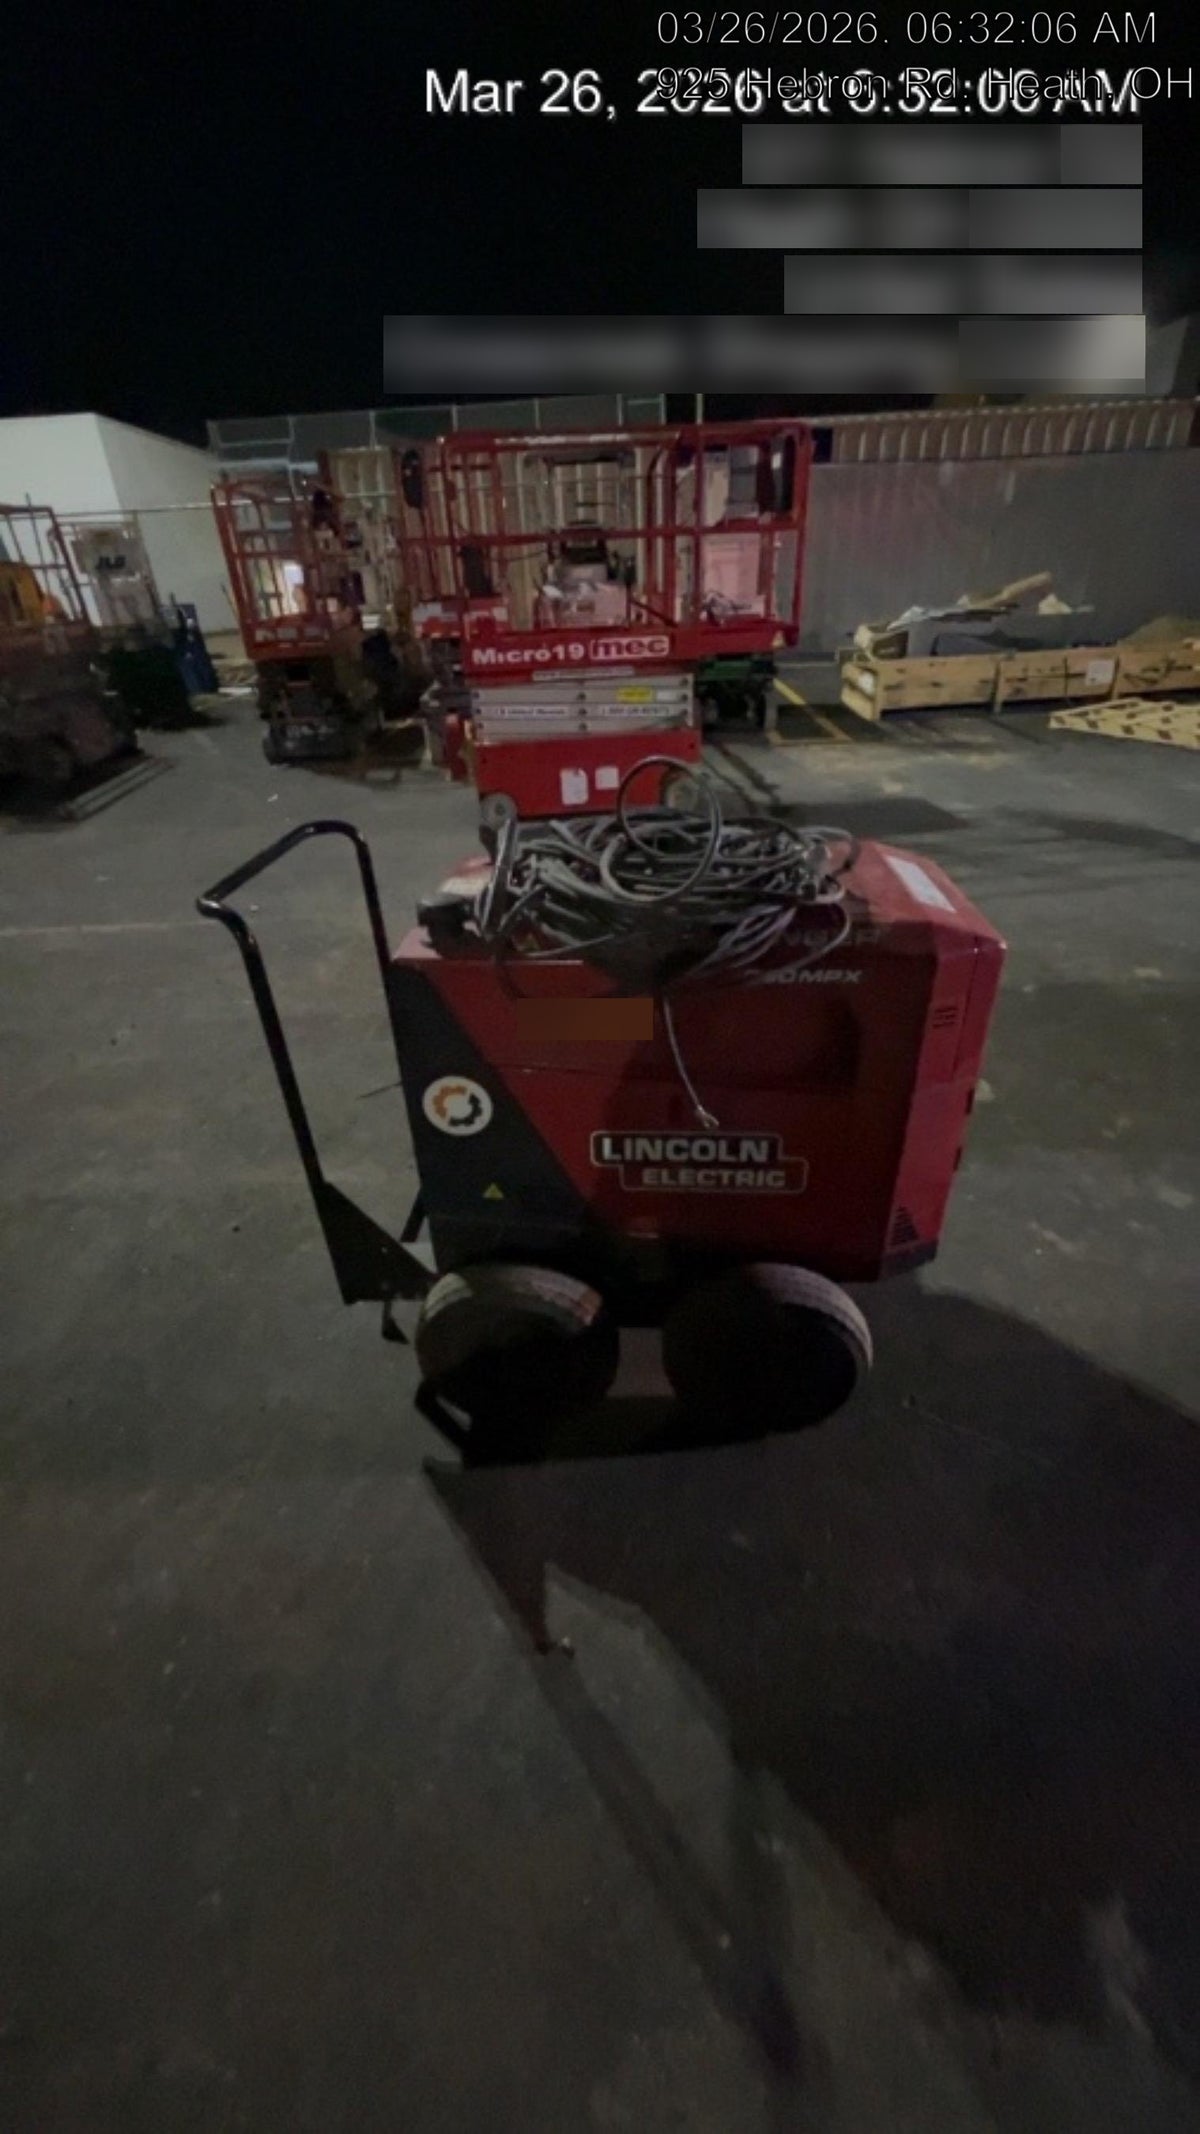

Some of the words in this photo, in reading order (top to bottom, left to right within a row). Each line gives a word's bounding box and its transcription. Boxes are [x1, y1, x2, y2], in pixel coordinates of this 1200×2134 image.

[471, 643, 586, 666] Micro19
[593, 637, 667, 658] mec
[600, 1136, 770, 1163] LINCOLN
[641, 1168, 786, 1188] ELECTRIC
